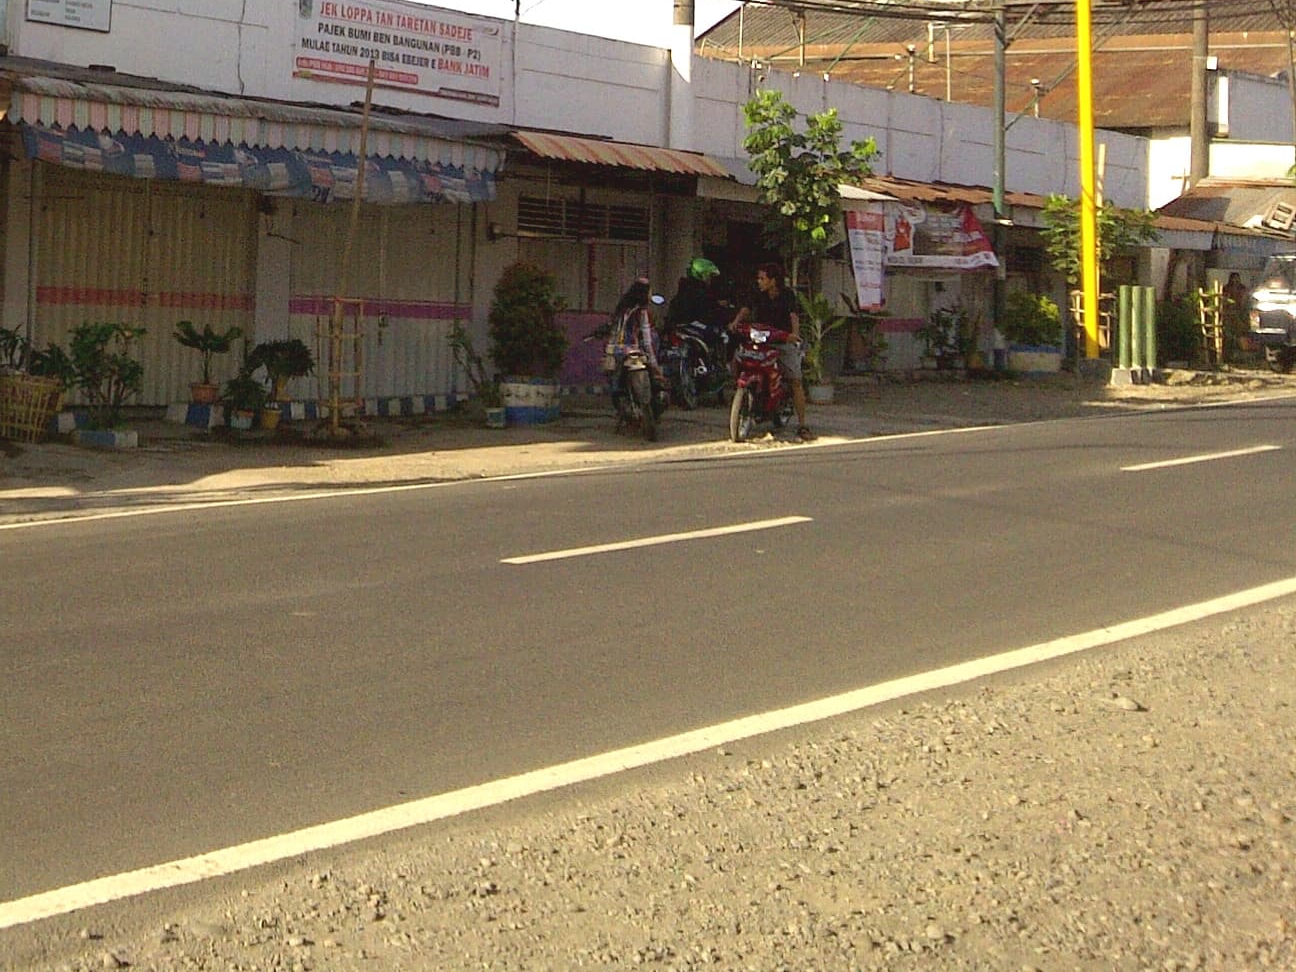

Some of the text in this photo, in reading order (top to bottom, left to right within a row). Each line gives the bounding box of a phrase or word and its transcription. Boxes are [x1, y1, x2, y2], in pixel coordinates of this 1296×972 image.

[320, 2, 473, 41] JEK LOPPA TAN TARETAN SADEJE
[302, 37, 330, 53] MULAE
[332, 42, 358, 56] TAHUN
[360, 46, 380, 60] 2013
[382, 51, 400, 63] BISA
[431, 59, 436, 69] E
[438, 57, 463, 73] BANK
[464, 63, 489, 78] JATIM
[318, 22, 345, 37] PAJEK
[348, 28, 371, 41] BUMI
[373, 31, 391, 44] BEN
[393, 35, 440, 53] BANGUNAN
[467, 48, 481, 62] P2)
